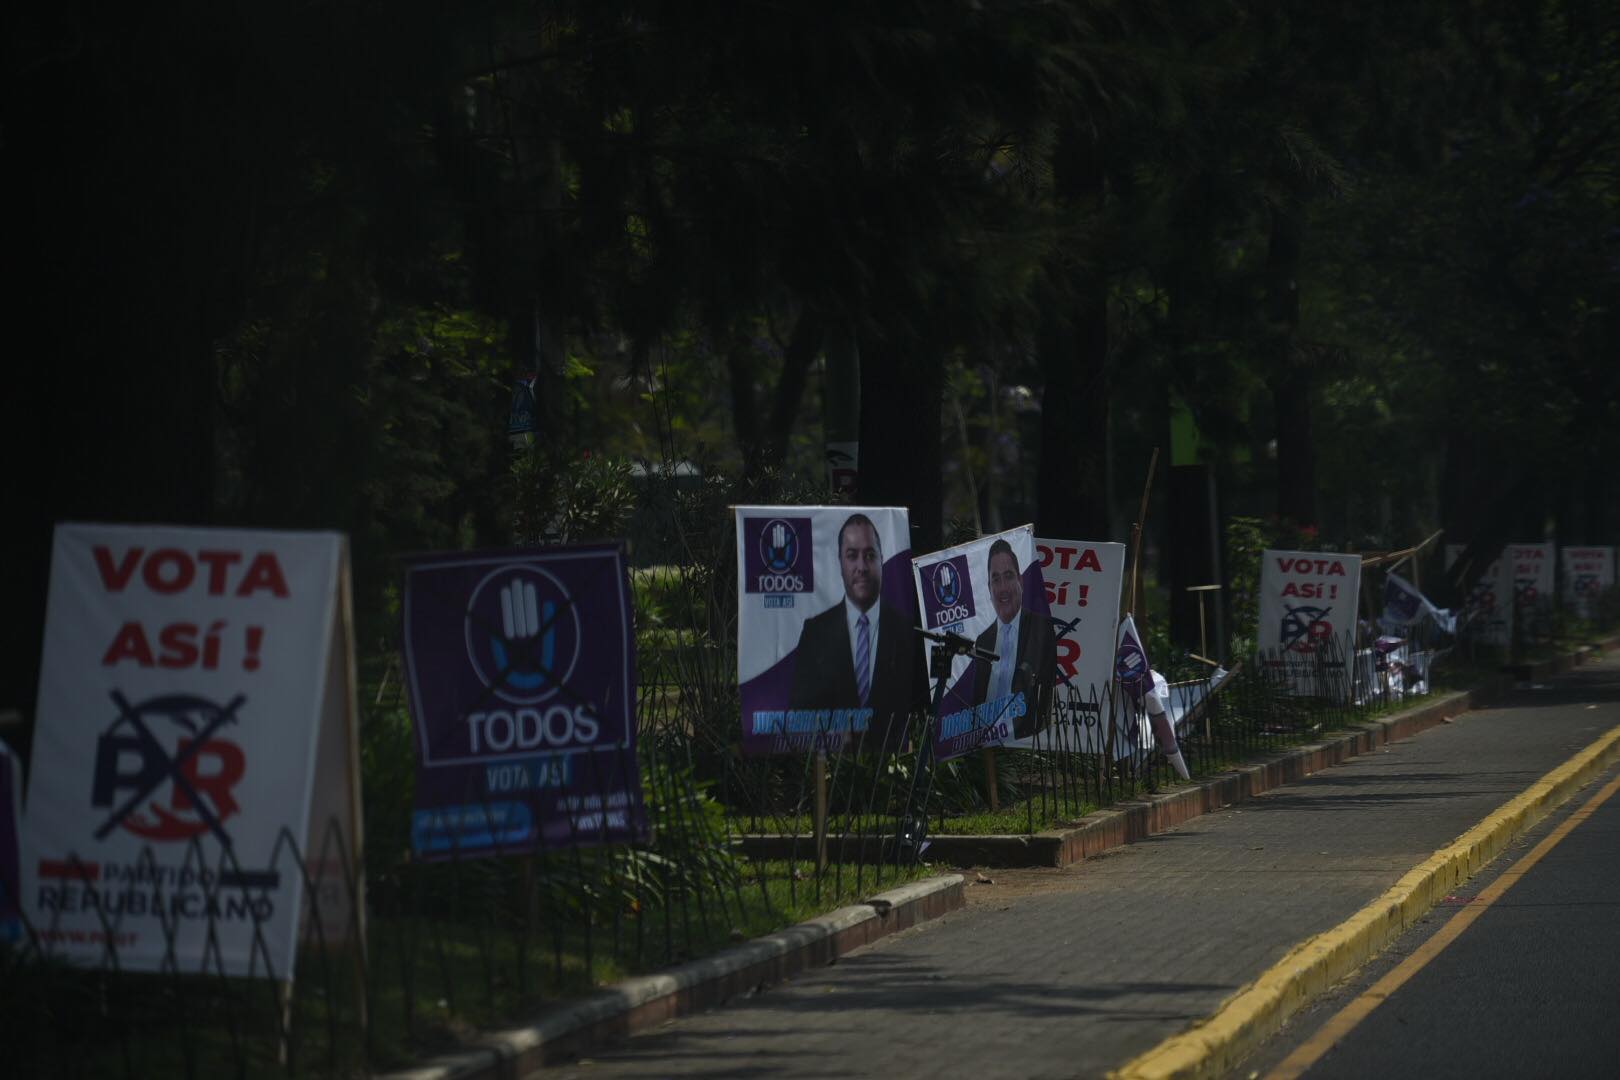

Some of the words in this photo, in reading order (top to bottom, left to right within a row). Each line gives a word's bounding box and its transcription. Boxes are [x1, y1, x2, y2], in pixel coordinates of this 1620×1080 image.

[92, 546, 290, 598] VOTA
[1036, 545, 1103, 572] OTA
[1277, 558, 1345, 576] VOTA
[759, 575, 804, 592] TODOS
[936, 605, 969, 626] TODOS
[467, 704, 599, 753] TODOS
[487, 765, 530, 792] VOTA
[103, 862, 215, 887] PARTIDO
[38, 886, 274, 922] REPUBLICANO
